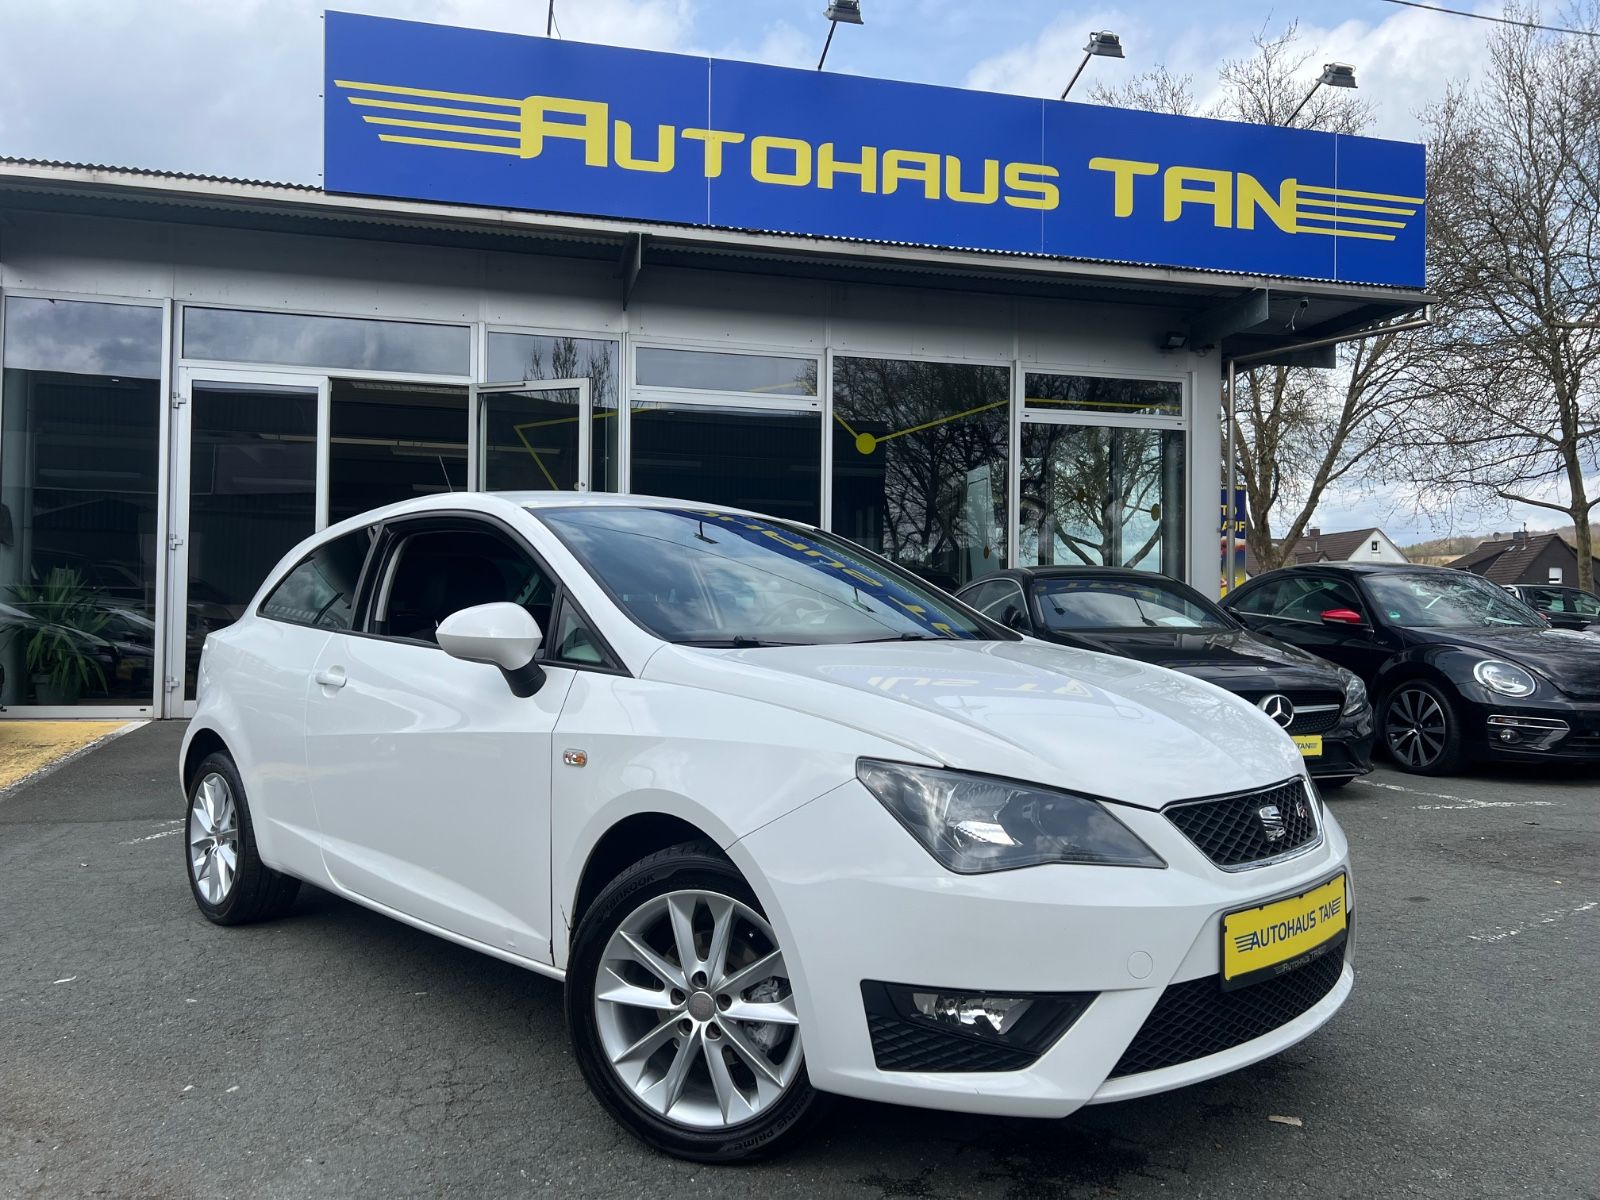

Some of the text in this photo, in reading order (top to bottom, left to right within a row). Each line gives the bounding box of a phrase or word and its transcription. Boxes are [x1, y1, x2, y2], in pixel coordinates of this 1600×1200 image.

[518, 94, 1298, 236] AUTOHAUS TAN
[1248, 909, 1317, 951] AUTOHAUS
